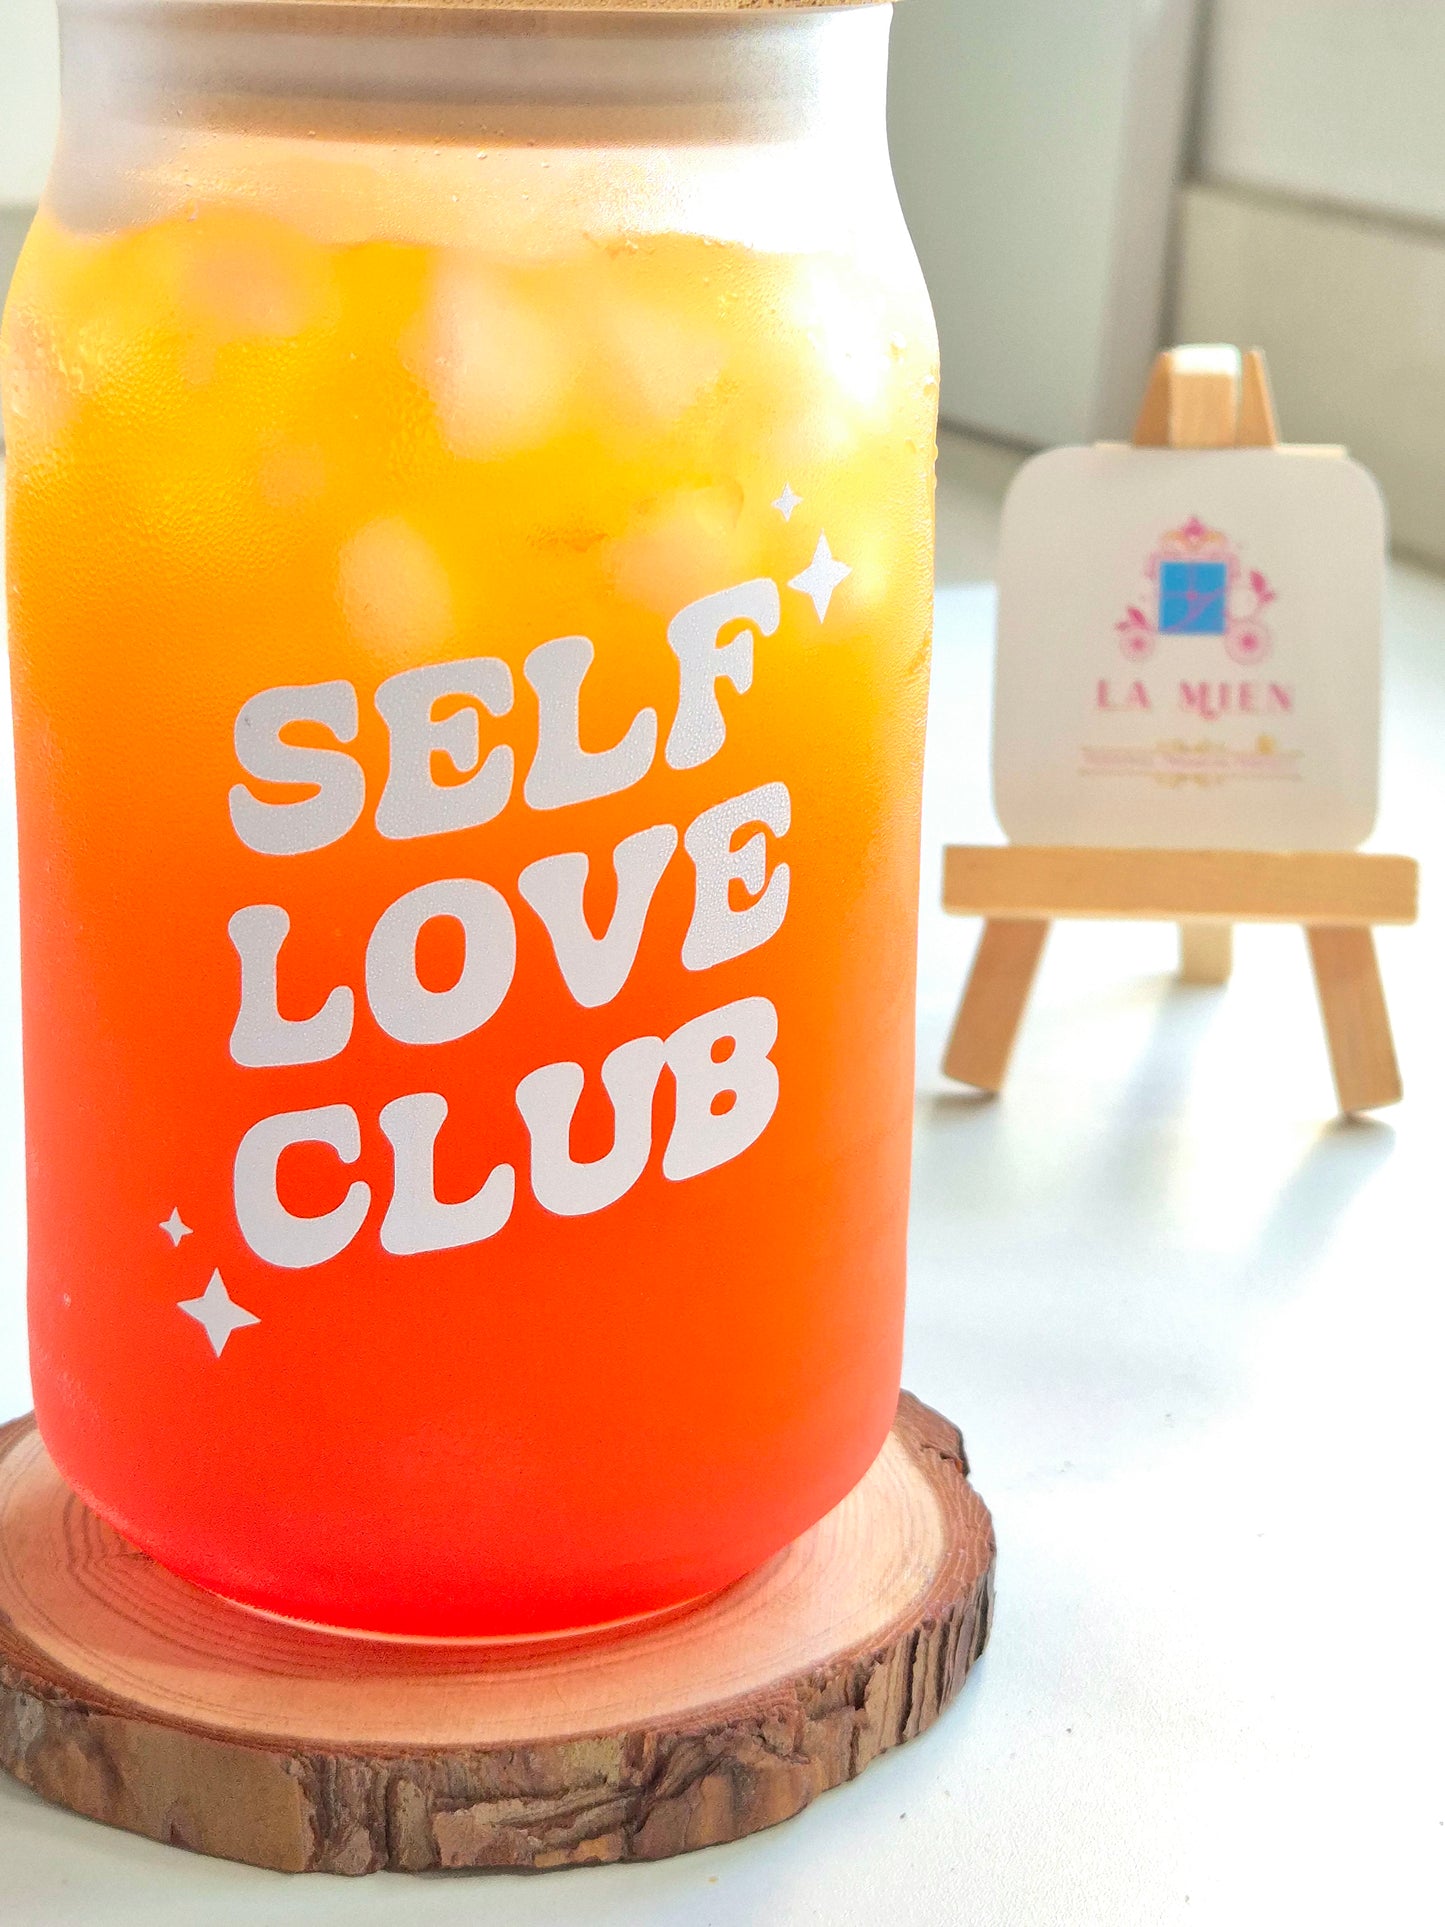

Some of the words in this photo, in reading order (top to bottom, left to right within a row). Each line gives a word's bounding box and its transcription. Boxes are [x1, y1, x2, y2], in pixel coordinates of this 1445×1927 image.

[229, 577, 782, 856] SELF
[1096, 678, 1151, 712] LA
[228, 781, 792, 1067] LOVE
[233, 996, 780, 1269] CLUB
